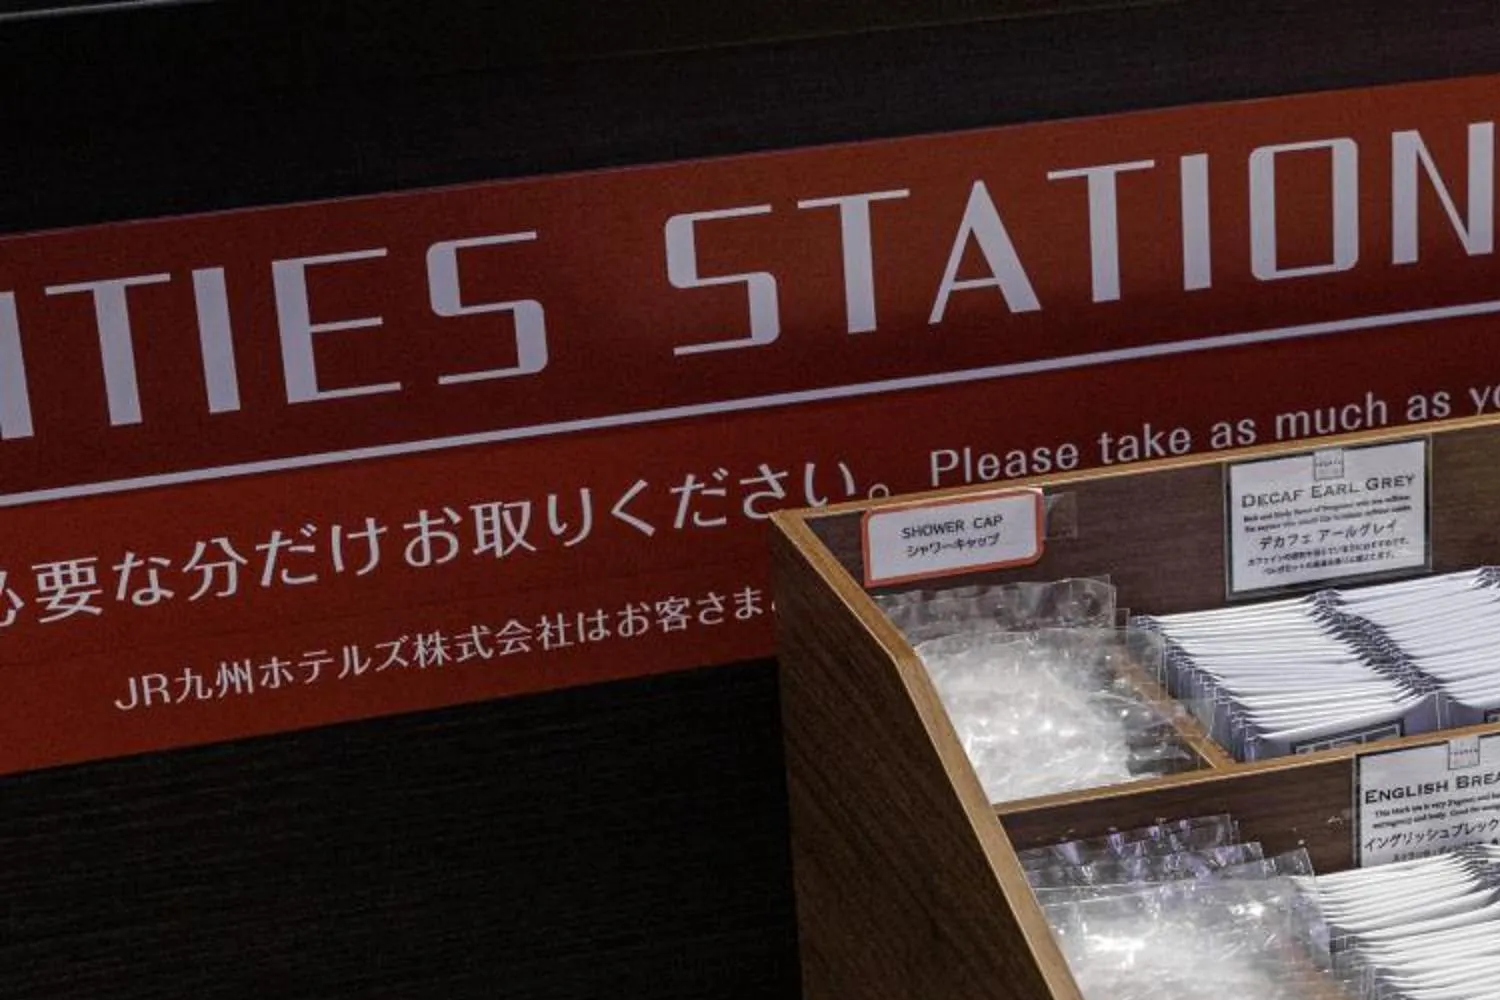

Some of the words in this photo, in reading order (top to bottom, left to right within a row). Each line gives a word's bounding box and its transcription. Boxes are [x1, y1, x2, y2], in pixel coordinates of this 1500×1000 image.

[0, 231, 549, 439] ITIES
[664, 120, 1496, 357] STATION
[930, 441, 1079, 488] Please
[1100, 423, 1193, 464] take
[1211, 417, 1257, 449] as
[1275, 391, 1388, 440] much
[1406, 388, 1451, 420] as
[1241, 489, 1304, 508] DECAF
[1311, 482, 1360, 498] EARL
[1365, 474, 1416, 491] GREY
[901, 519, 965, 540] SHOWER
[973, 514, 1004, 530] CAP
[1259, 534, 1312, 550] デカフェ
[1319, 519, 1397, 541] アールグレイ
[114, 585, 775, 713] JR九州ホテルズ株式会社はお客さま
[1365, 780, 1449, 804] ENGLISH
